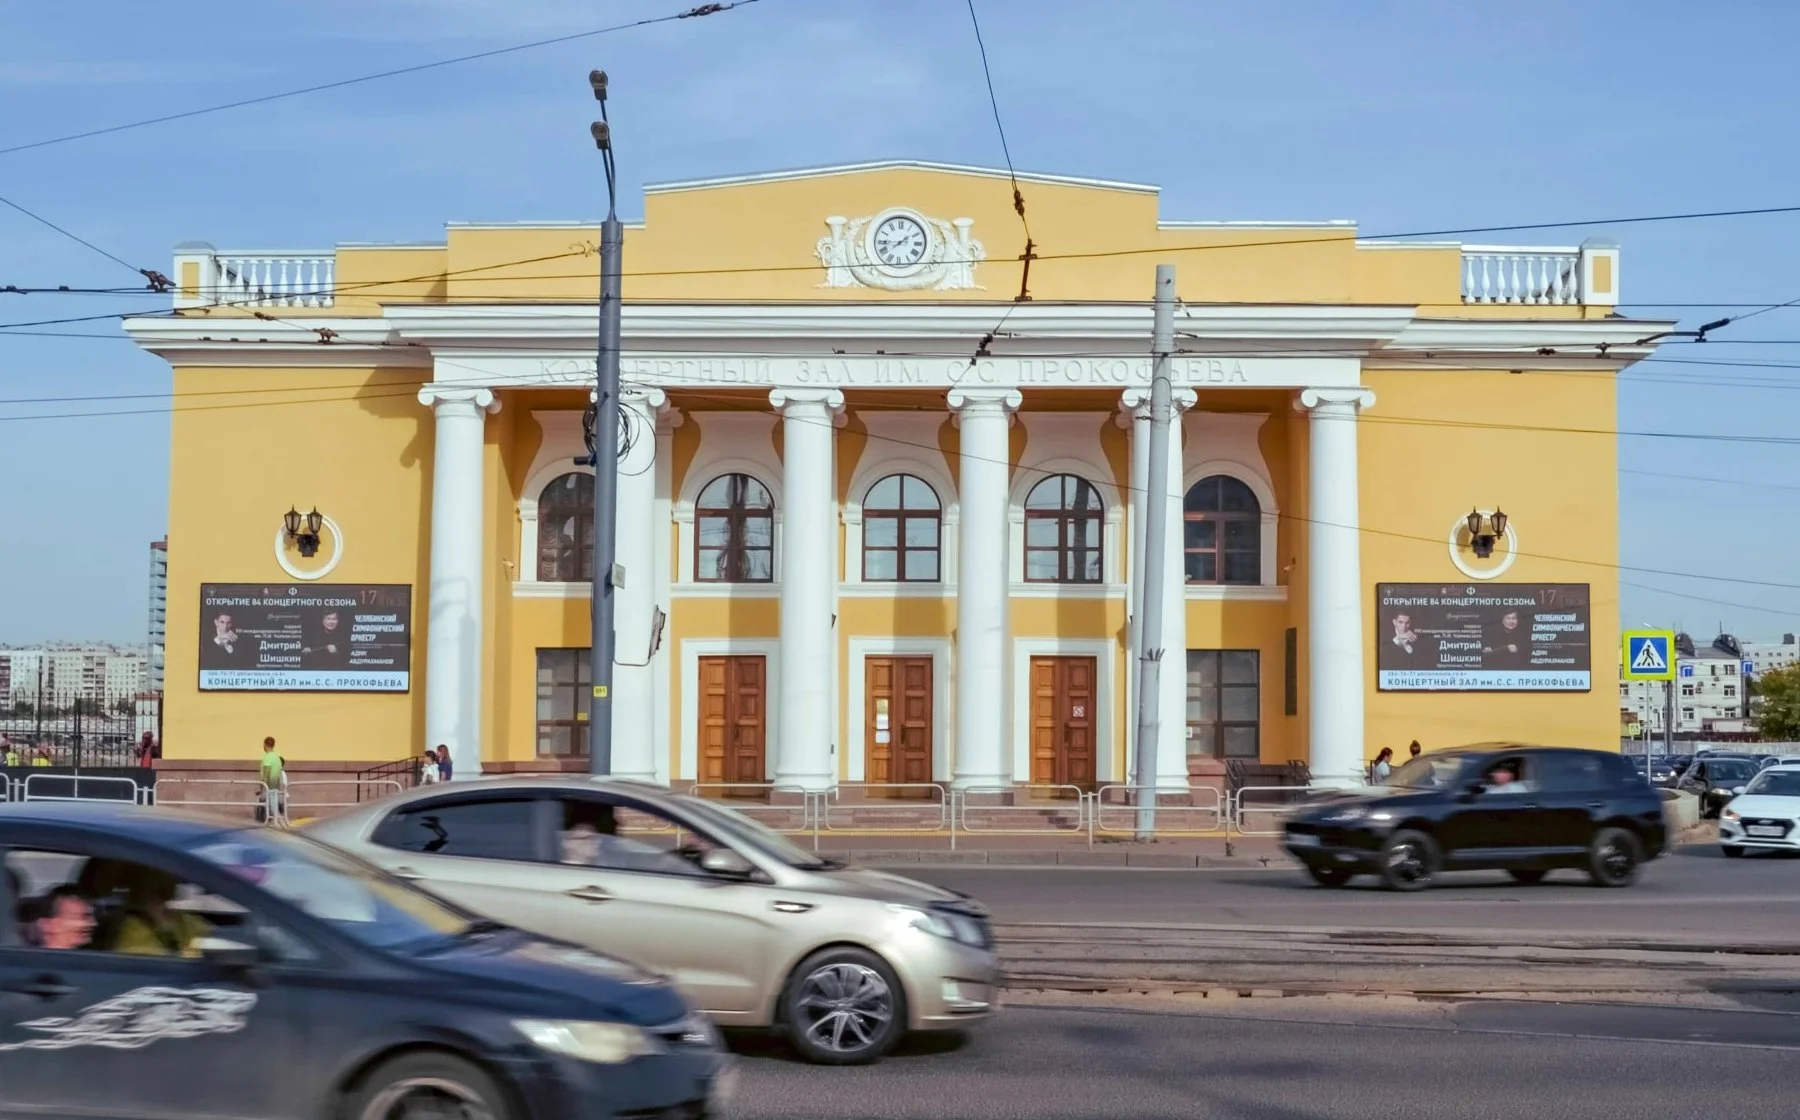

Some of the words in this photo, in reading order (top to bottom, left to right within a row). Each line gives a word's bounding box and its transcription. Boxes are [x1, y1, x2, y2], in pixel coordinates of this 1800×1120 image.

[539, 356, 772, 383] КОЕРТНЫЙ
[796, 360, 856, 383] ЗАЛ
[874, 360, 929, 383] ИМ.
[206, 598, 250, 606] ОТКРЫТИЕ
[263, 598, 323, 607] КОНЦЕРТНОГО
[324, 598, 357, 607] СЕЗОНА
[360, 590, 378, 605] 17
[1383, 597, 1429, 606] ОТКРЫТИЕ
[1441, 597, 1501, 607] КОНЦЕРТНОГО
[1503, 598, 1536, 606] СЕЗОНА
[259, 641, 301, 651] Дмитрий
[1439, 640, 1482, 651] Дмитрий
[260, 654, 301, 663] Шишкин
[1440, 653, 1482, 663] Шишкин
[208, 677, 275, 686] КОНЦЕРТНЫЙ
[278, 678, 297, 686] ЗАЛ
[336, 679, 403, 687] ПРОКОФЬЕВА
[1387, 676, 1456, 686] КОНЦЕРТНЫЙ
[1459, 678, 1478, 686] ЗАЛ
[1518, 679, 1585, 687] ПРОКОФЬЕВА
